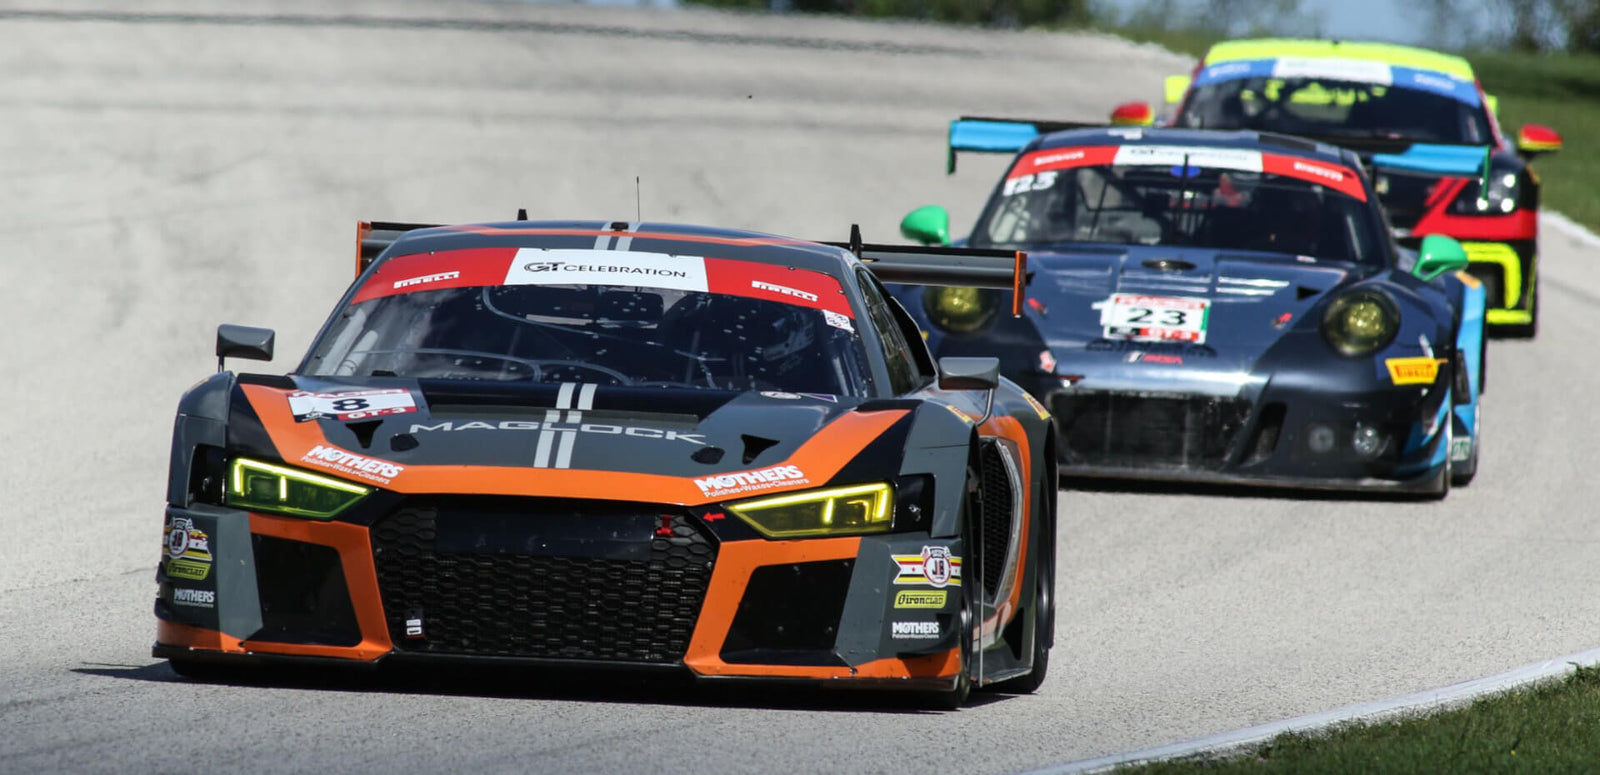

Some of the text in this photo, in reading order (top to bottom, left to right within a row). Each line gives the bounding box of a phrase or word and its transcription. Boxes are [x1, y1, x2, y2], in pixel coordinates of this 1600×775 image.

[524, 262, 686, 278] GT CELEBRATION
[393, 271, 460, 289] PIRELLI
[751, 280, 818, 302] PIRELLI
[1127, 308, 1187, 325] 23
[332, 398, 370, 411] 8
[347, 407, 406, 419] GT-3
[409, 421, 706, 445] MAGLOCK
[306, 445, 404, 478] MOTHERS
[693, 465, 804, 492] MOTHERS
[174, 588, 214, 603] MOTHERS
[892, 621, 939, 634] MOTHERS
